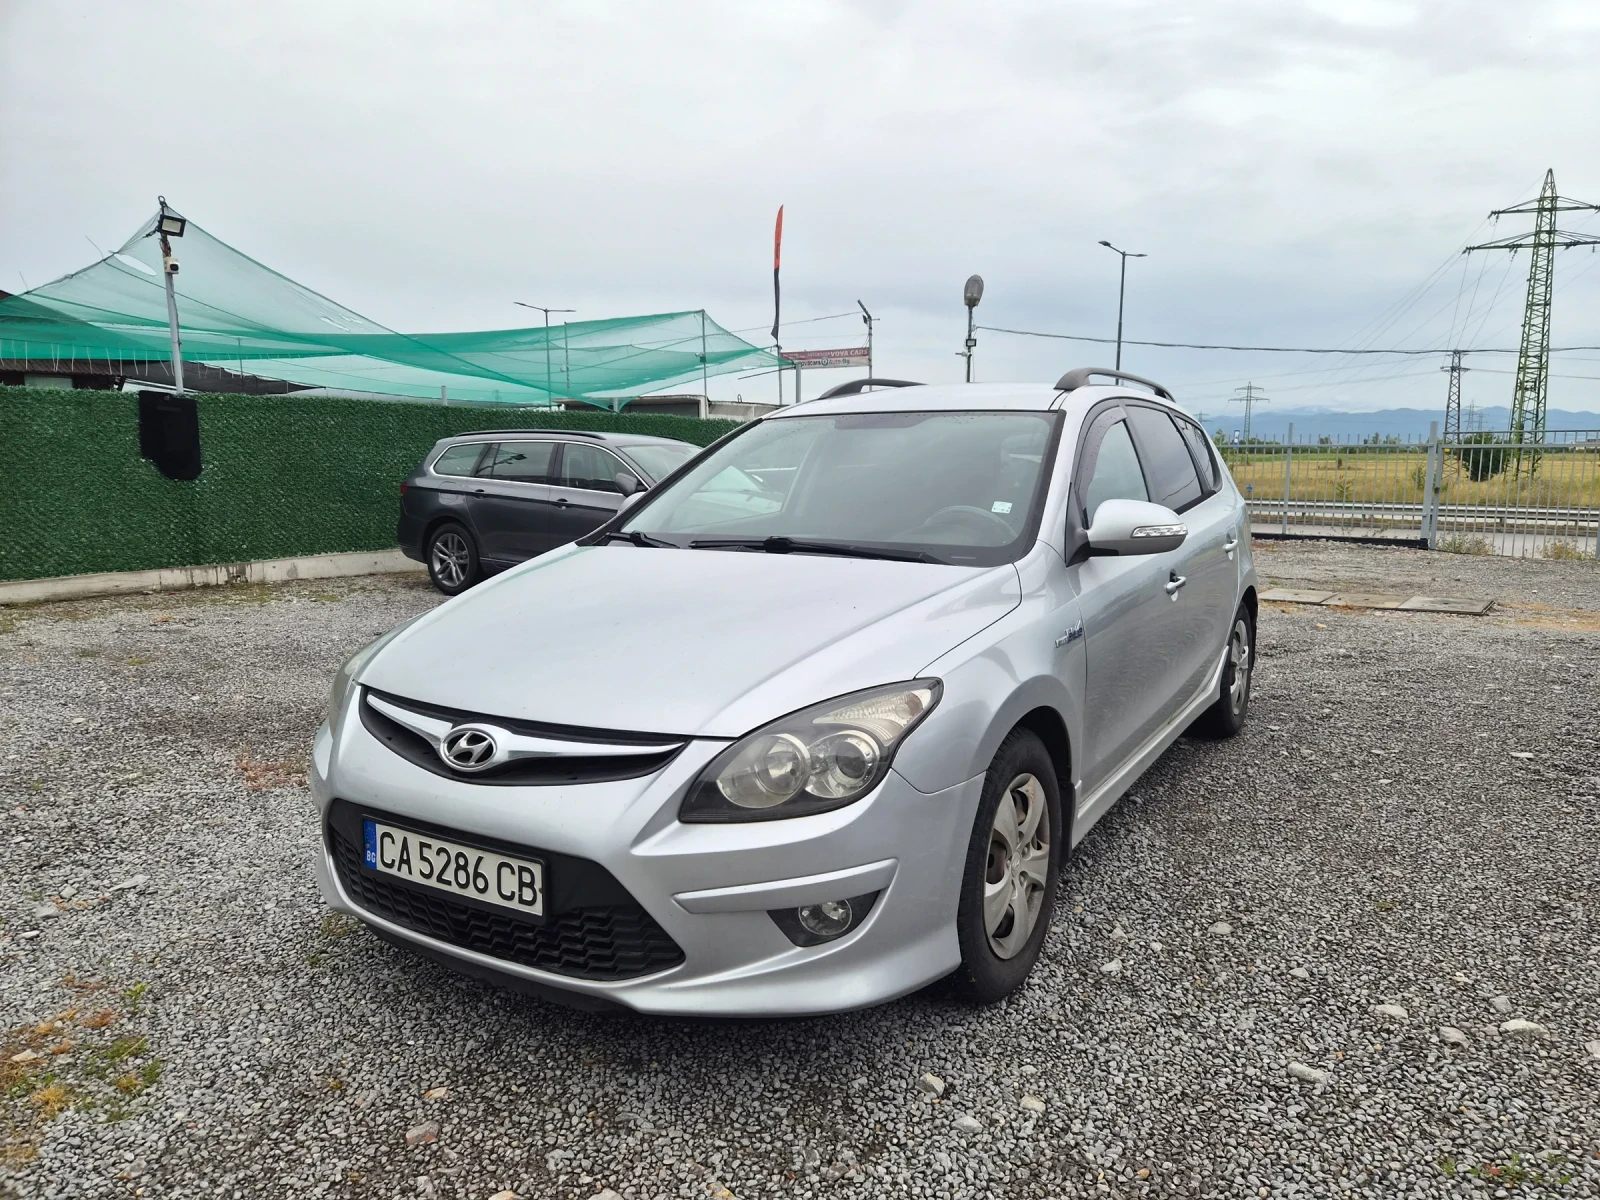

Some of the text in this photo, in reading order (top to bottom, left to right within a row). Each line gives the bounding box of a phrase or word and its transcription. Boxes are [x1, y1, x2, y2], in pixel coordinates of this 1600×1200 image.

[366, 850, 376, 863] BG
[379, 831, 538, 906] CA 5286 CB
